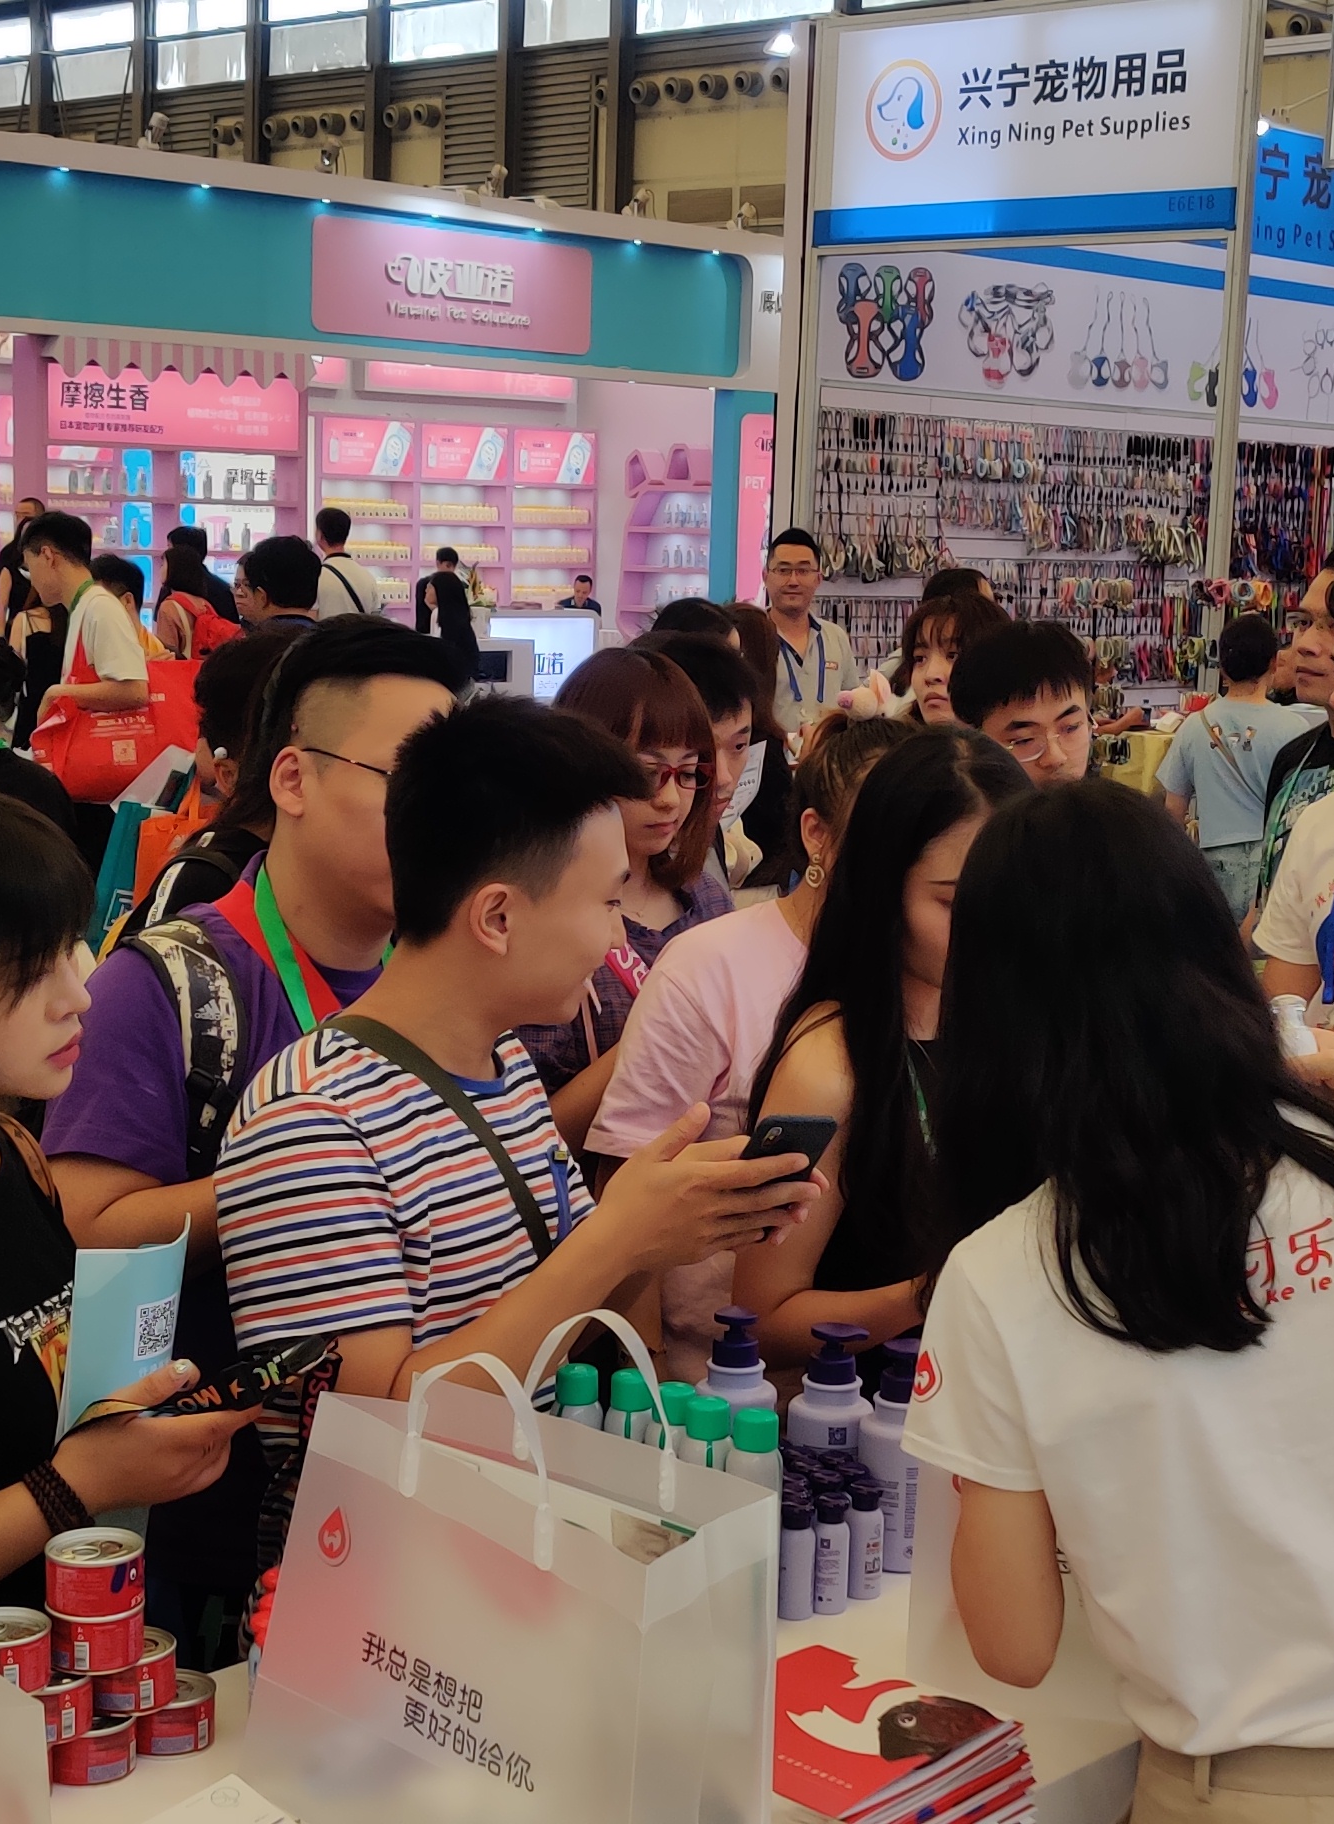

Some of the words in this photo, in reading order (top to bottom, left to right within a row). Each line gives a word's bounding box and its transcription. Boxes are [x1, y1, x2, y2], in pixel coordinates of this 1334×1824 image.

[958, 48, 1188, 111] 兴宁宠物用品
[957, 125, 1002, 149] Xing
[1008, 121, 1055, 146] Ning
[1062, 118, 1094, 139] Pet
[1099, 110, 1191, 140] Supplies
[1168, 194, 1215, 212] E6E18
[1255, 216, 1286, 249] ing
[1293, 224, 1322, 250] Pet
[60, 381, 150, 412] 摩擦生香
[1265, 1286, 1295, 1305] ke
[1310, 1276, 1333, 1294] le
[361, 1631, 484, 1724] 我总是想把
[403, 1694, 535, 1793] 更好的给你
